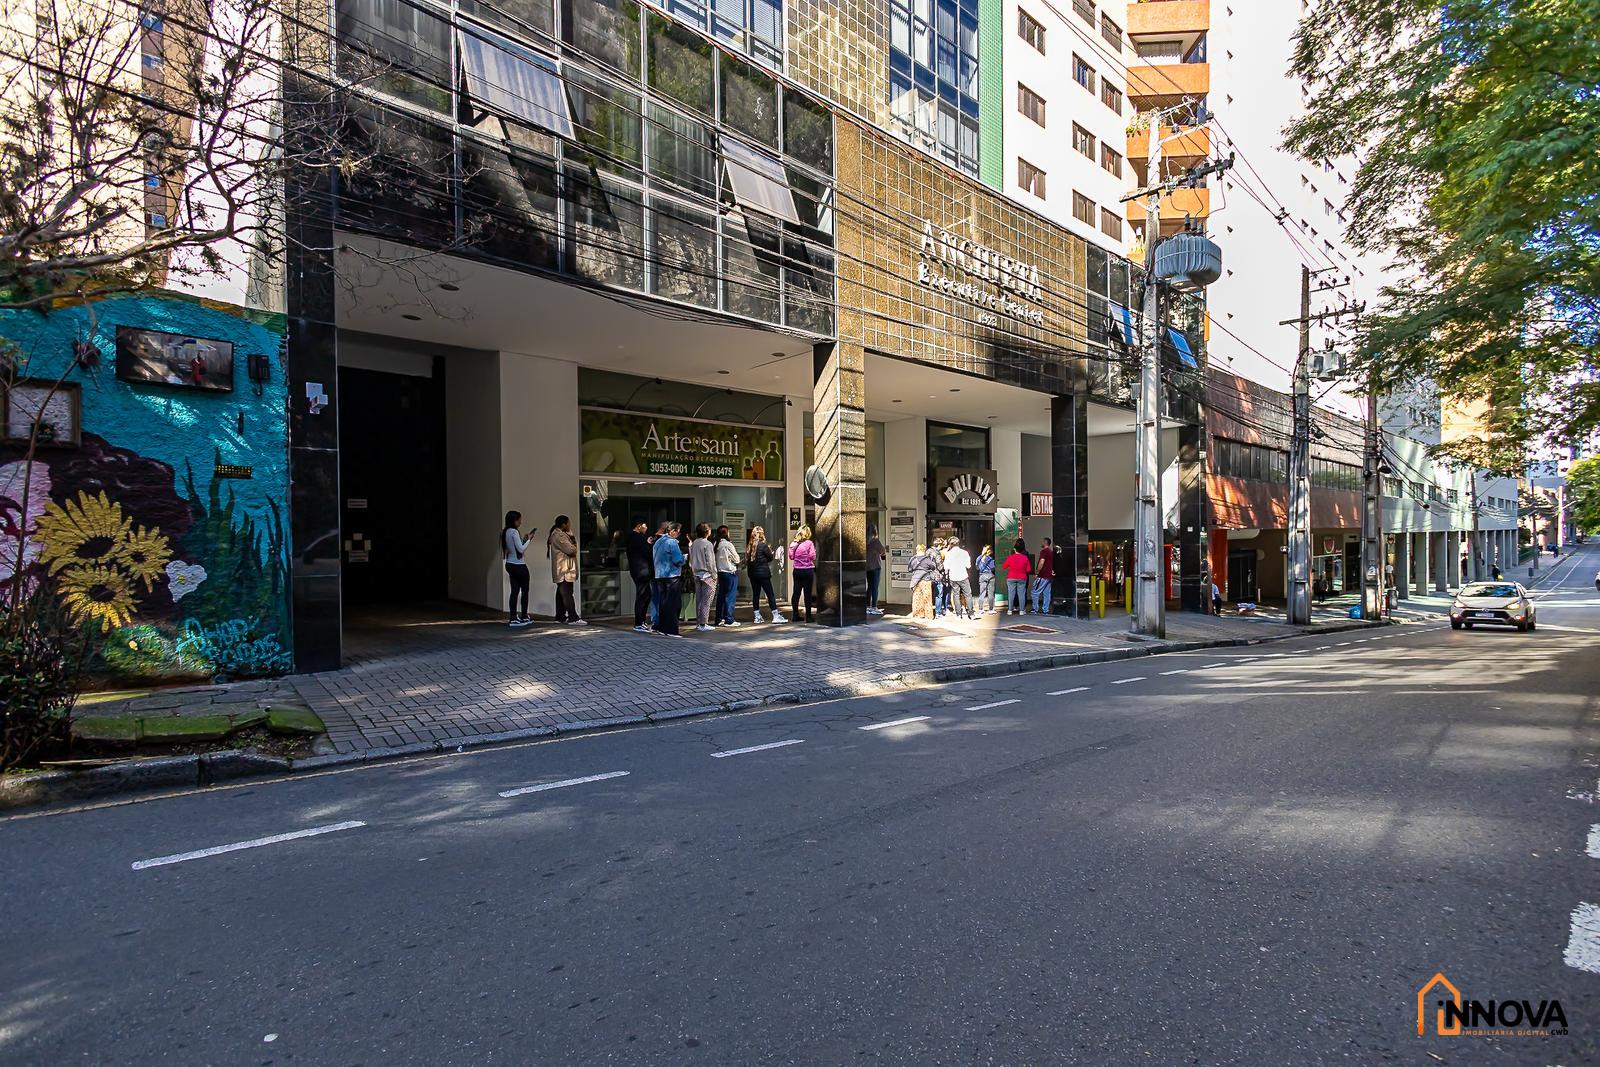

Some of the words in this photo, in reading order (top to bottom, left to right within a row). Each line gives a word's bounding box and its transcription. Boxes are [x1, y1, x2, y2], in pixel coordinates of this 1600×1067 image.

[919, 219, 1042, 299] ANCHIETA
[918, 261, 996, 310] Executive
[999, 293, 1043, 325] Center
[650, 462, 688, 474] 3053-0001
[697, 465, 733, 476] 3336-6475
[943, 474, 971, 504] BALI
[974, 476, 996, 505] HAI
